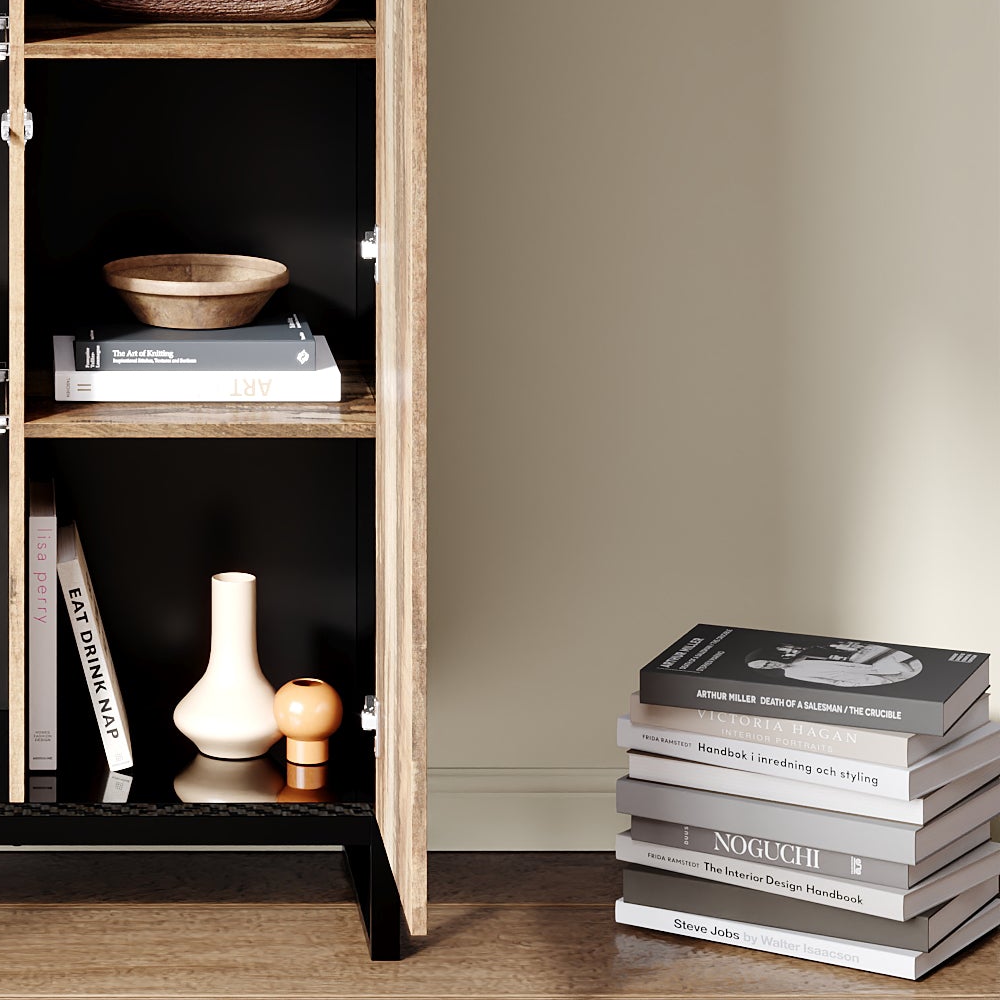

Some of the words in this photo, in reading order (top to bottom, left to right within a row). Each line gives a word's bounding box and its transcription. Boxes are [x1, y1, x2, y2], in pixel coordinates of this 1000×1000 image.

[147, 350, 174, 359] Knitting
[229, 378, 273, 397] ART
[36, 528, 52, 562] lisa
[33, 571, 47, 624] perry
[68, 587, 89, 624] EAT
[80, 630, 107, 694] DRINK
[98, 698, 119, 740] NAP
[696, 689, 727, 701] ARTHUR
[728, 693, 756, 704] MILLER
[760, 696, 785, 707] DEATH
[785, 699, 796, 708] OF
[797, 700, 803, 709] A
[804, 701, 843, 713] SALESMAN
[849, 706, 864, 716] THE
[864, 707, 902, 720] CRUCIBLE
[642, 734, 660, 742] FRIDA
[660, 738, 692, 748] RAMSTEDT
[697, 710, 784, 732] VICTORIA
[792, 723, 858, 744] HAGAN
[721, 728, 771, 743] INTERIOR
[698, 742, 748, 761] Handbok
[758, 753, 812, 775] inredning
[816, 765, 837, 777] och
[840, 770, 878, 787] styling
[647, 853, 666, 861] FRIDA
[667, 857, 700, 868] RAMSTEDT
[713, 831, 820, 869] NOGUCHI
[703, 862, 723, 874] The
[725, 866, 763, 883] Interior
[766, 875, 802, 892] Design
[806, 884, 863, 904] Handbook
[673, 918, 707, 934] Steve
[710, 925, 740, 940] Jobs
[743, 931, 758, 945] by
[760, 935, 801, 951] Walter
[803, 943, 860, 963] Isaacson
